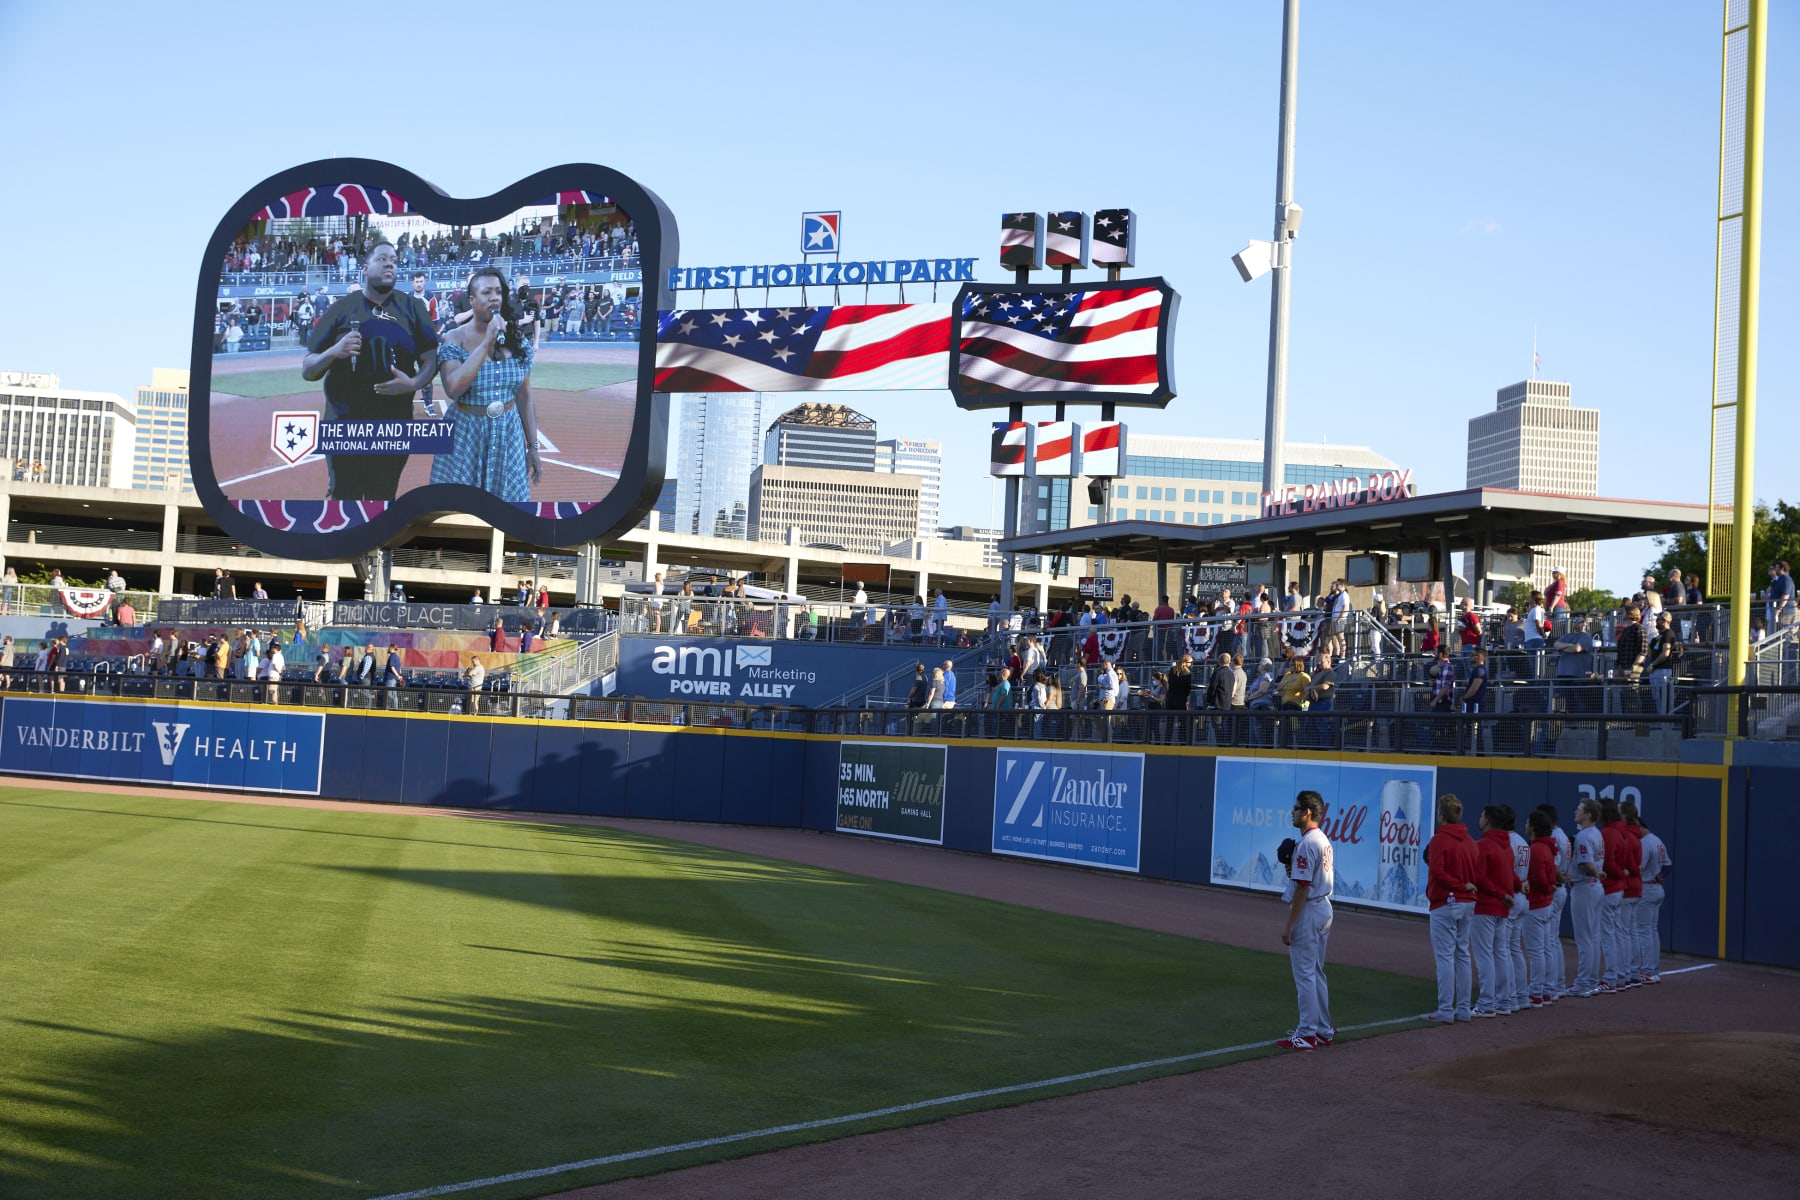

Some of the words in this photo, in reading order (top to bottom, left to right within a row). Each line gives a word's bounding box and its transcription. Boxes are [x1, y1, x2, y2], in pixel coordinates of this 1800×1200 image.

[610, 272, 635, 281] FIELD
[668, 264, 747, 290] FIRST
[750, 260, 887, 288] HORIZON
[894, 258, 975, 282] PARK
[321, 424, 344, 437] THE
[346, 424, 375, 437] WAR
[378, 423, 403, 437] AND
[406, 422, 454, 437] TREATY
[321, 440, 369, 451] NATIONAL
[371, 440, 411, 450] ANTHEM
[1261, 487, 1300, 519] THE
[1303, 476, 1362, 512] BAND
[1366, 468, 1414, 503] BOX
[336, 604, 391, 623] PICNIC
[397, 605, 454, 625] PLACE
[652, 645, 732, 677] ami
[748, 667, 816, 684] Marketing
[670, 679, 731, 696] POWER
[740, 682, 796, 699] ALLEY
[16, 725, 146, 753] VANDERBILT
[194, 736, 298, 763] HEALTH
[840, 762, 852, 781] 35
[854, 763, 876, 782] MIN.
[897, 770, 945, 806] Mint
[1051, 766, 1128, 808] Zander
[839, 787, 855, 806] I-65
[855, 788, 889, 810] NORTH
[839, 813, 859, 829] GAME
[860, 815, 873, 830] ON!
[900, 807, 919, 817] GAMING
[1051, 808, 1123, 832] INSURANCE
[1231, 806, 1273, 828] MADE
[1317, 802, 1368, 844] hill
[1379, 810, 1421, 847] Coors
[1090, 844, 1126, 856] zander.com
[1381, 846, 1418, 867] LIGHT
